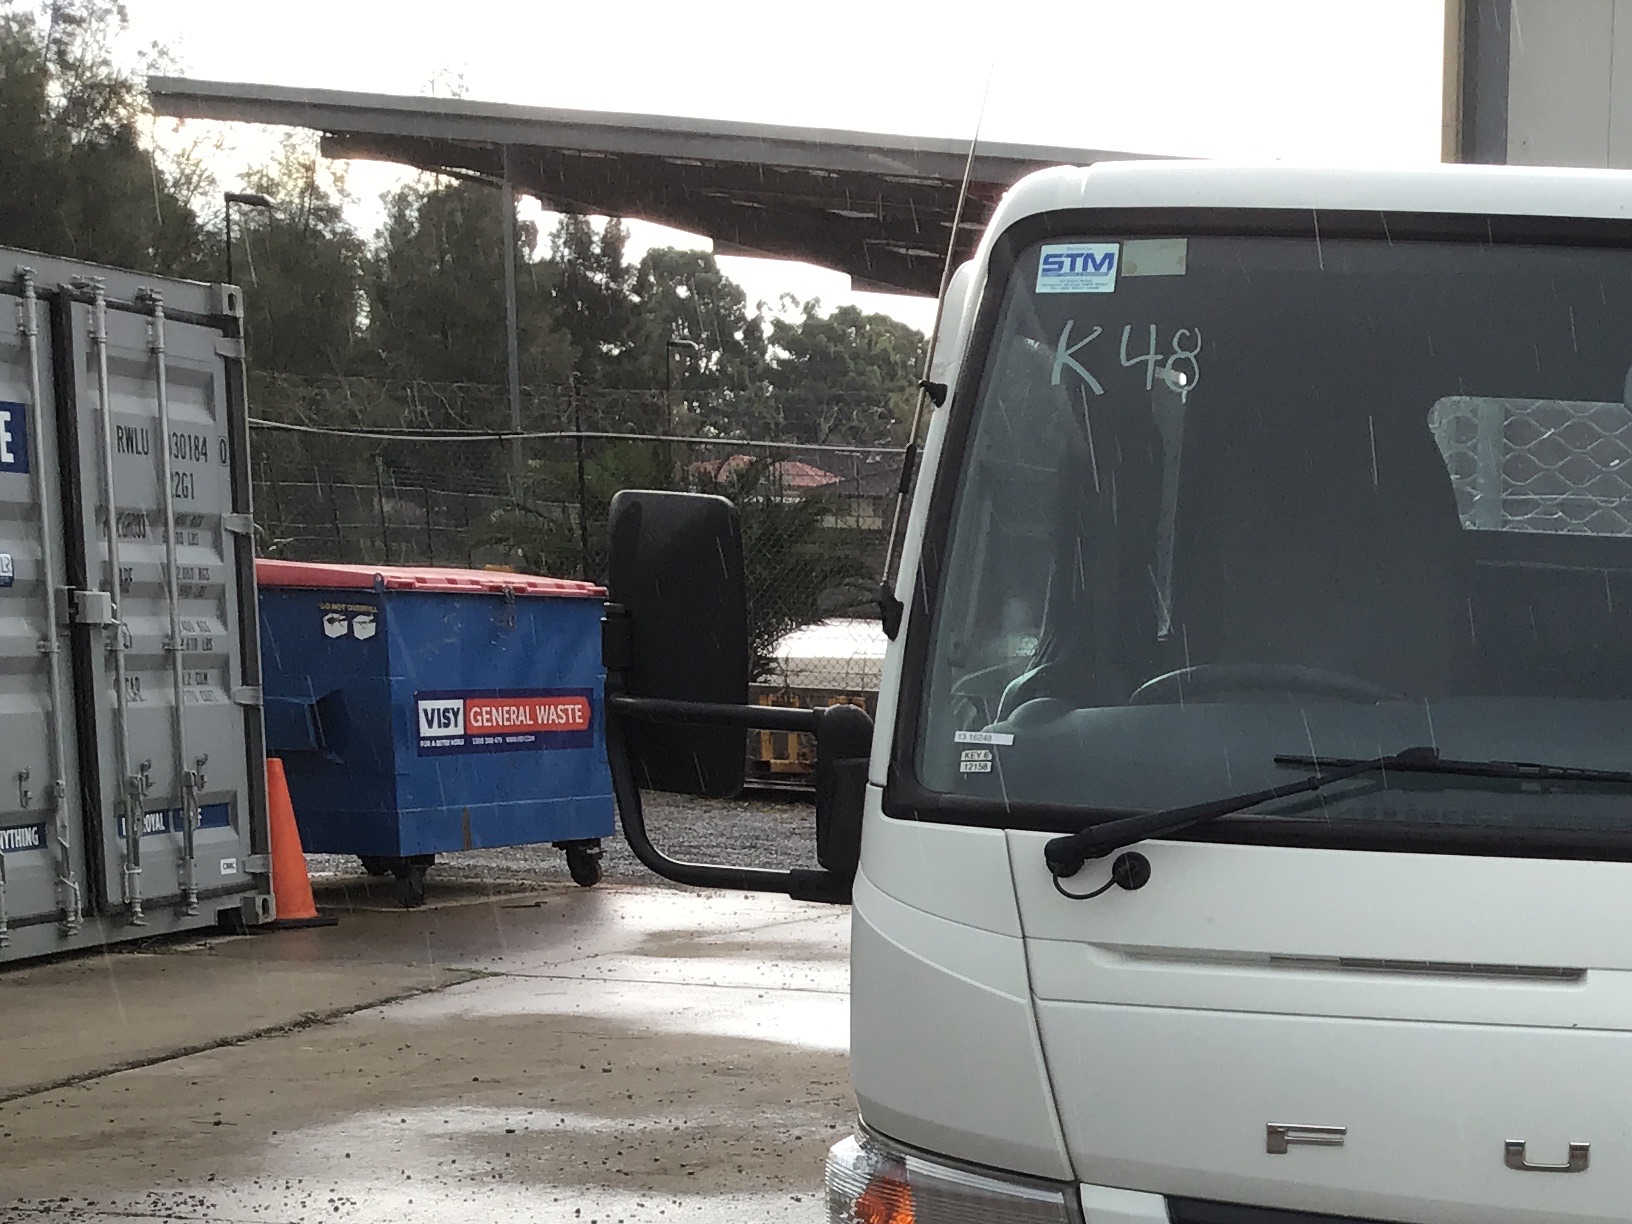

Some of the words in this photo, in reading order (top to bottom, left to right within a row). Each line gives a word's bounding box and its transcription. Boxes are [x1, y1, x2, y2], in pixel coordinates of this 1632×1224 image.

[1042, 252, 1115, 272] STM
[1051, 319, 1105, 394] K
[1119, 324, 1202, 393] 48
[116, 424, 149, 455] RWLU
[170, 471, 194, 499] 2G1
[422, 707, 461, 730] VISY
[470, 705, 534, 727] GENERAL
[536, 704, 584, 724] WASTE
[964, 751, 982, 759] KEY
